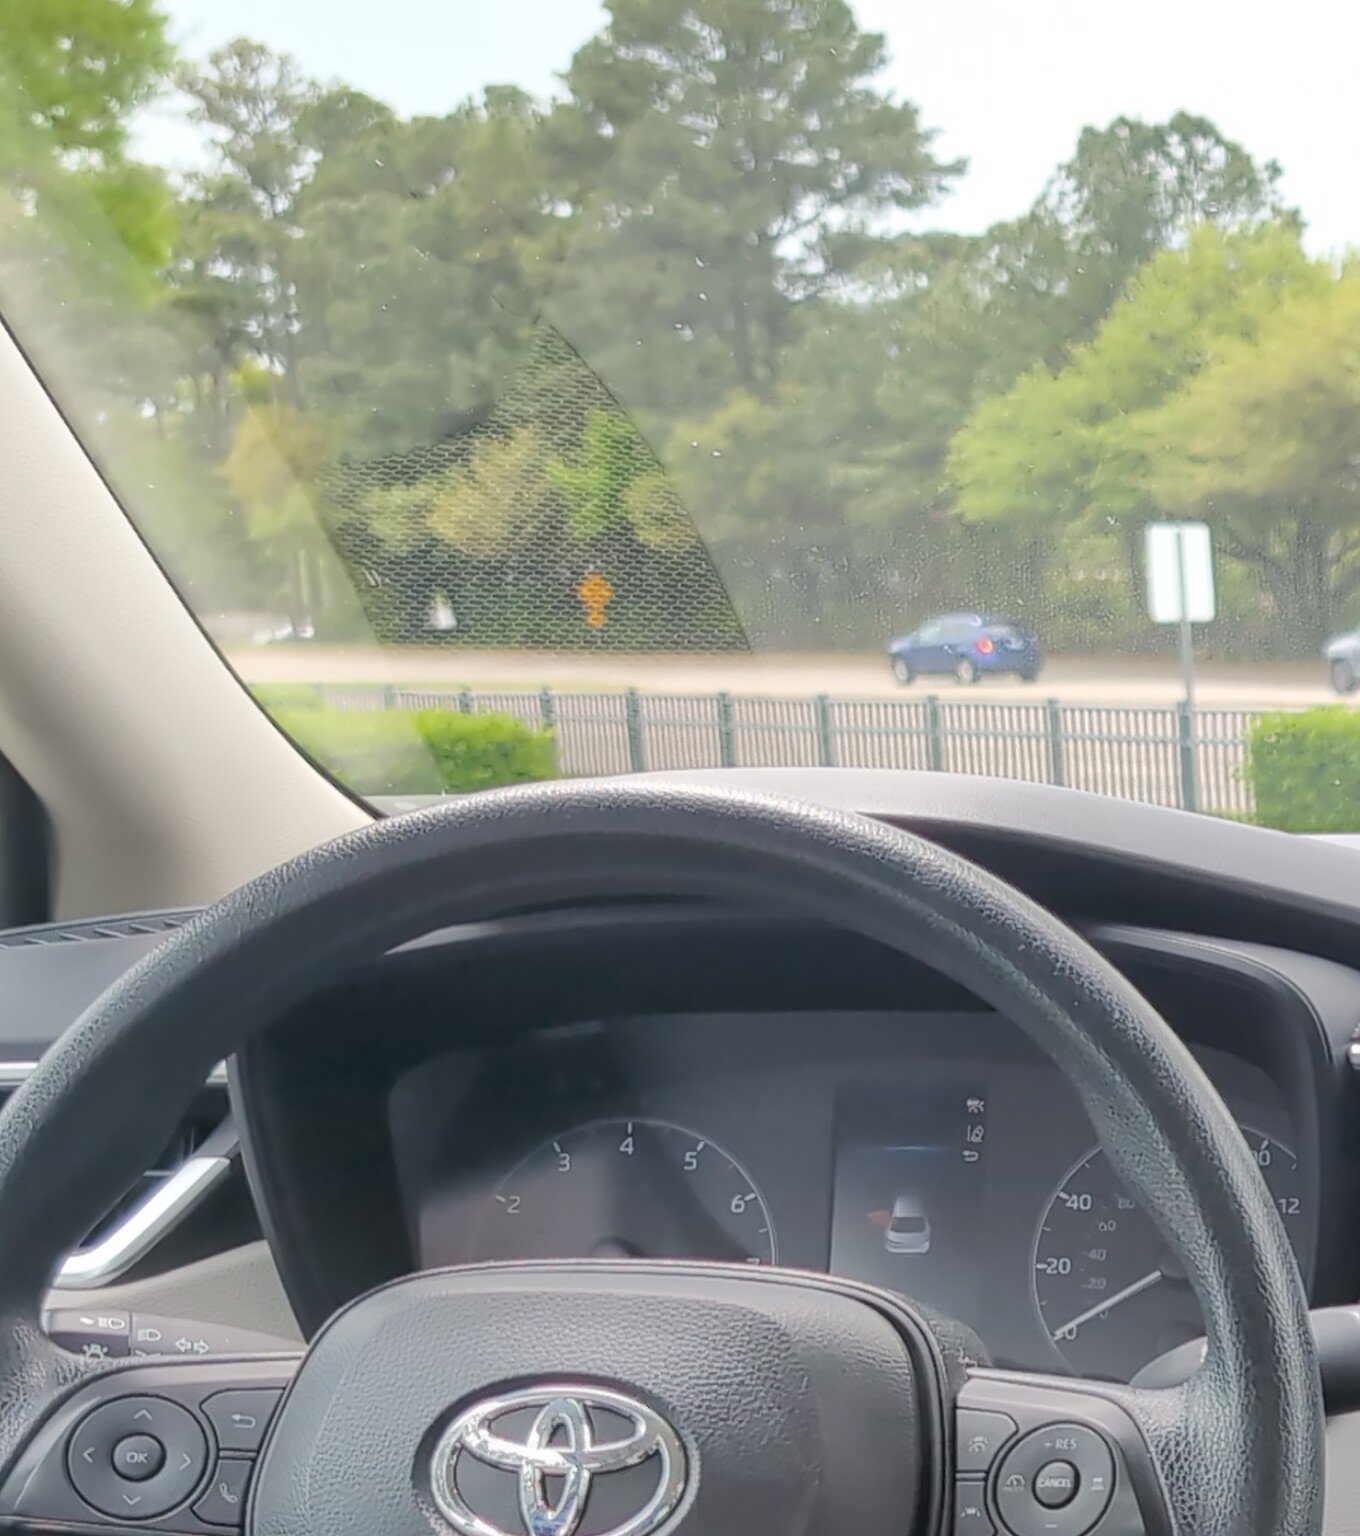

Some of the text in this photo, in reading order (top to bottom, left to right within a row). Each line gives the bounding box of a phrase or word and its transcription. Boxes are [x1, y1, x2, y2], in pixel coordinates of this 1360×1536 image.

[619, 1137, 634, 1155] 4
[558, 1152, 571, 1171] 3
[683, 1151, 698, 1170] 5
[507, 1195, 521, 1213] 2
[730, 1194, 746, 1213] 6
[1065, 1193, 1092, 1211] 40
[1278, 1196, 1300, 1214] 12
[1088, 1248, 1107, 1261] 40
[1045, 1257, 1071, 1275] 20
[1055, 1437, 1077, 1450] RES
[126, 1451, 149, 1465] OK
[1038, 1478, 1072, 1489] CANCEL
